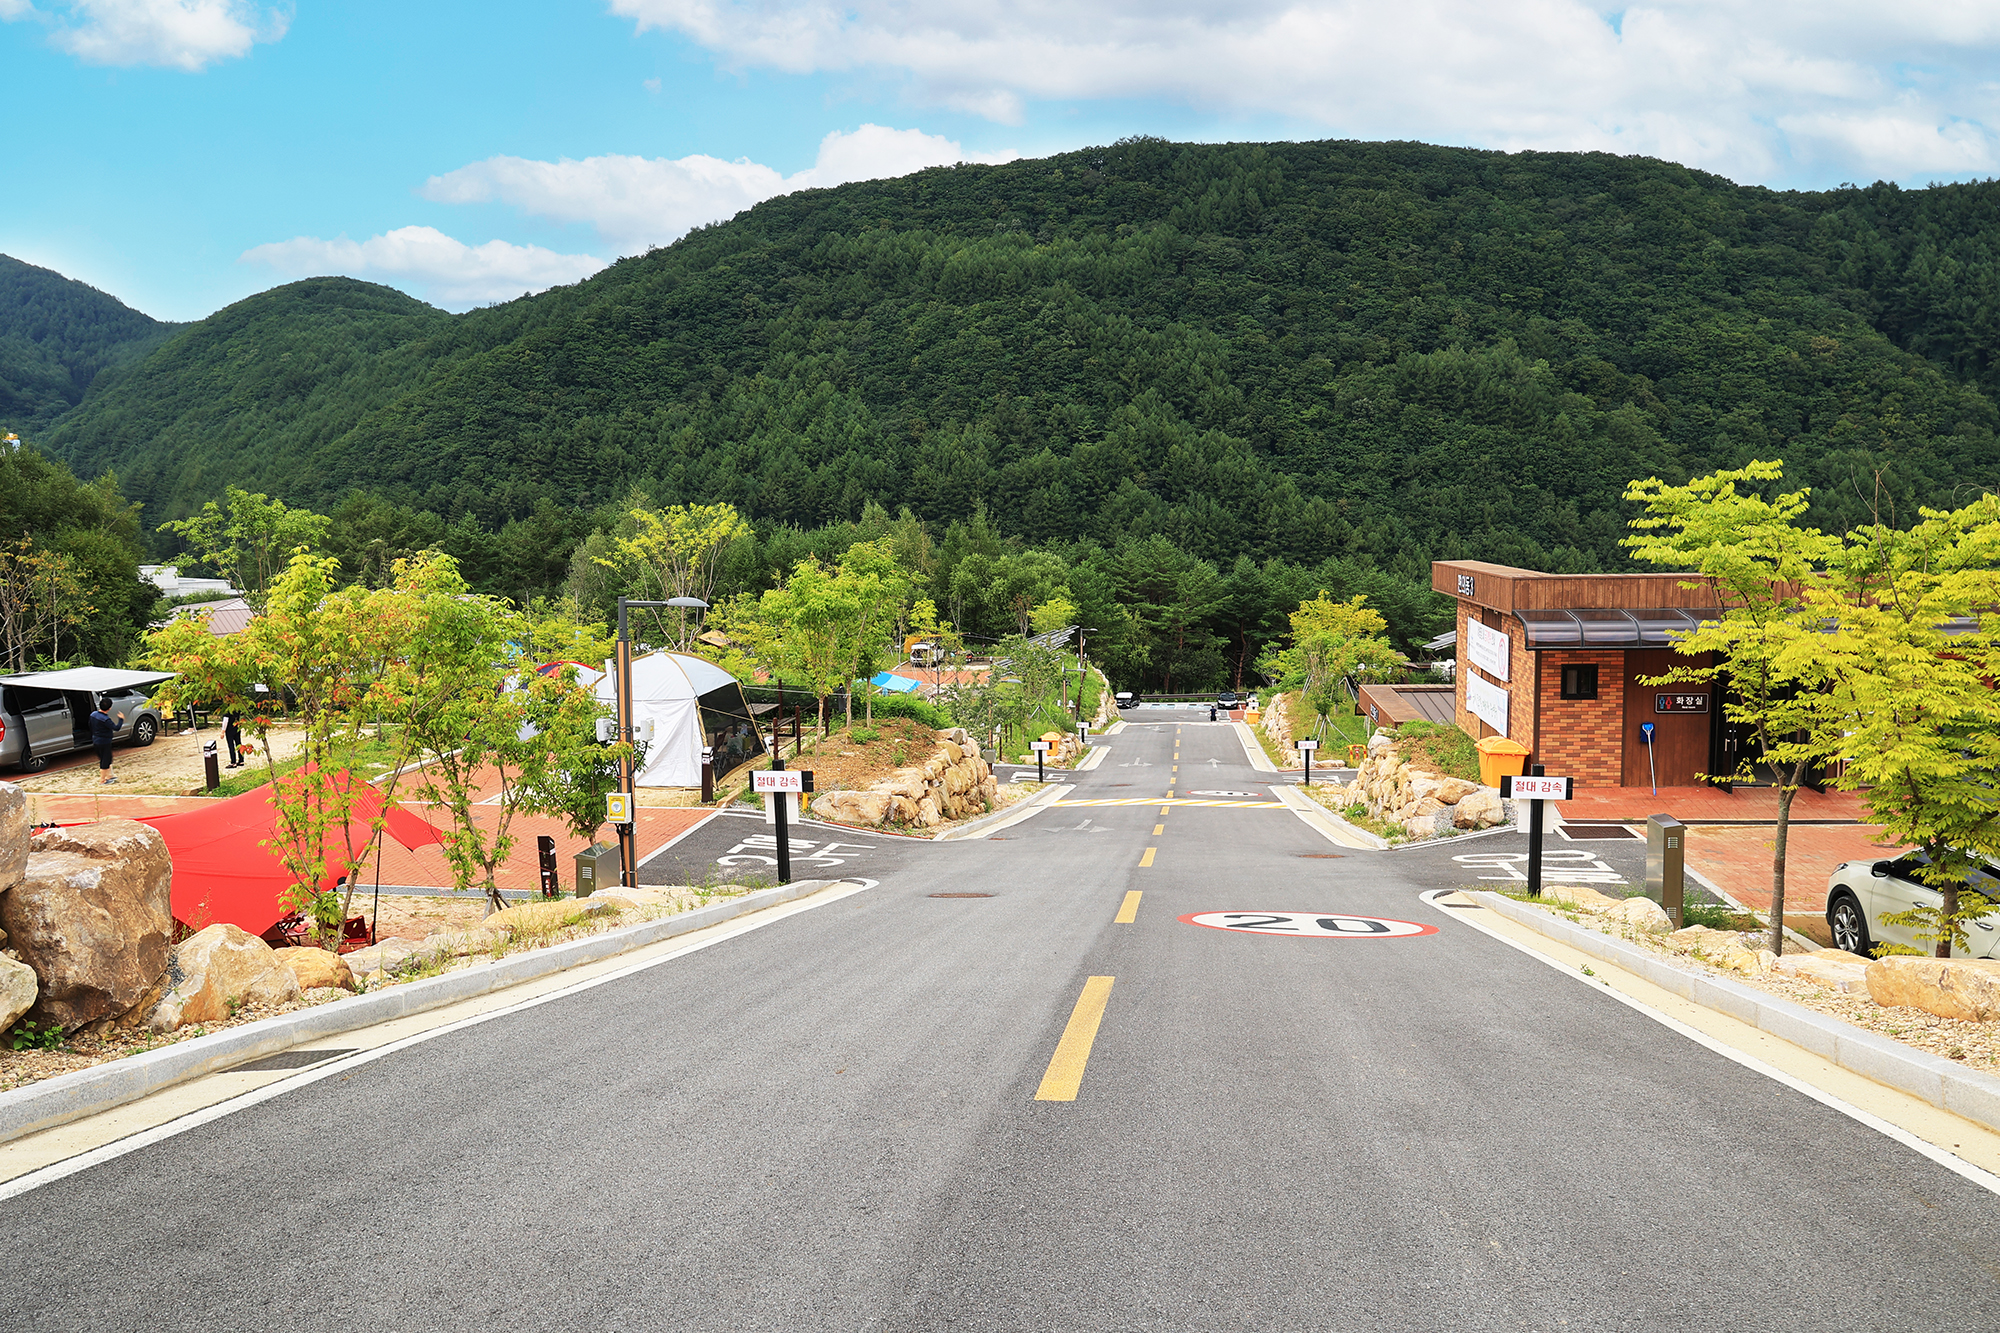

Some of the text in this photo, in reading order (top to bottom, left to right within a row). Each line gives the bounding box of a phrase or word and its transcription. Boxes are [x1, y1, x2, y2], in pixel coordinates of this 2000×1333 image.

[1675, 696, 1703, 705] 화장실
[756, 776, 799, 788] 절대 감속
[1515, 780, 1562, 793] 절대 감속
[1224, 914, 1391, 933] 20
